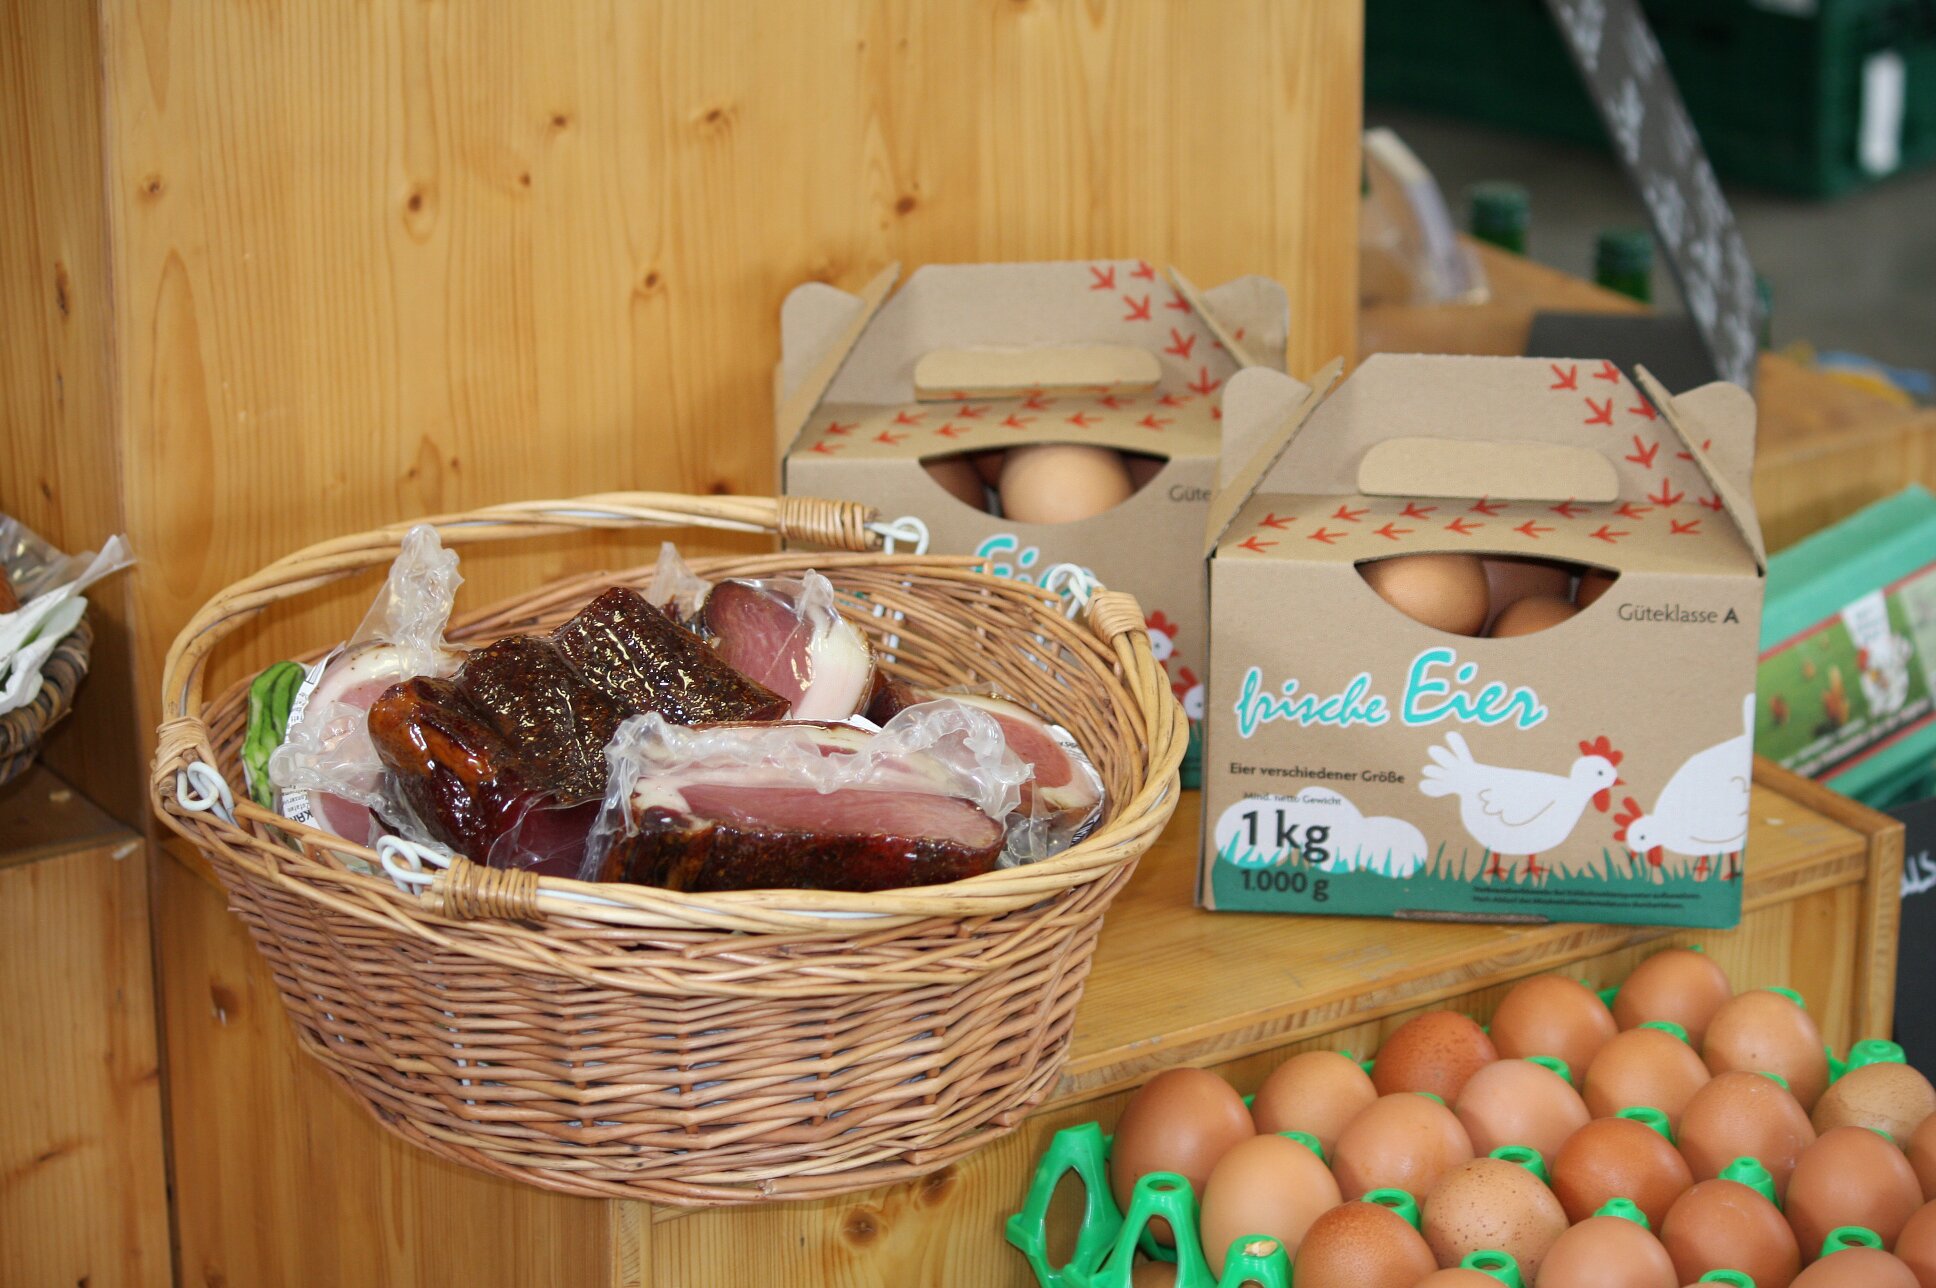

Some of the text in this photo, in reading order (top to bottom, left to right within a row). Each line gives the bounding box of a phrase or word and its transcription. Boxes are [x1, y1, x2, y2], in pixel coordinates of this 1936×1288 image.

[1618, 602, 1740, 624] Güteklasse A
[1235, 646, 1548, 738] frische Eier
[1230, 762, 1405, 784] Eier verschiedener Größe
[1302, 794, 1342, 806] Gewicht
[1242, 808, 1331, 863] 1 kg
[1240, 869, 1330, 902] 1.000 g
